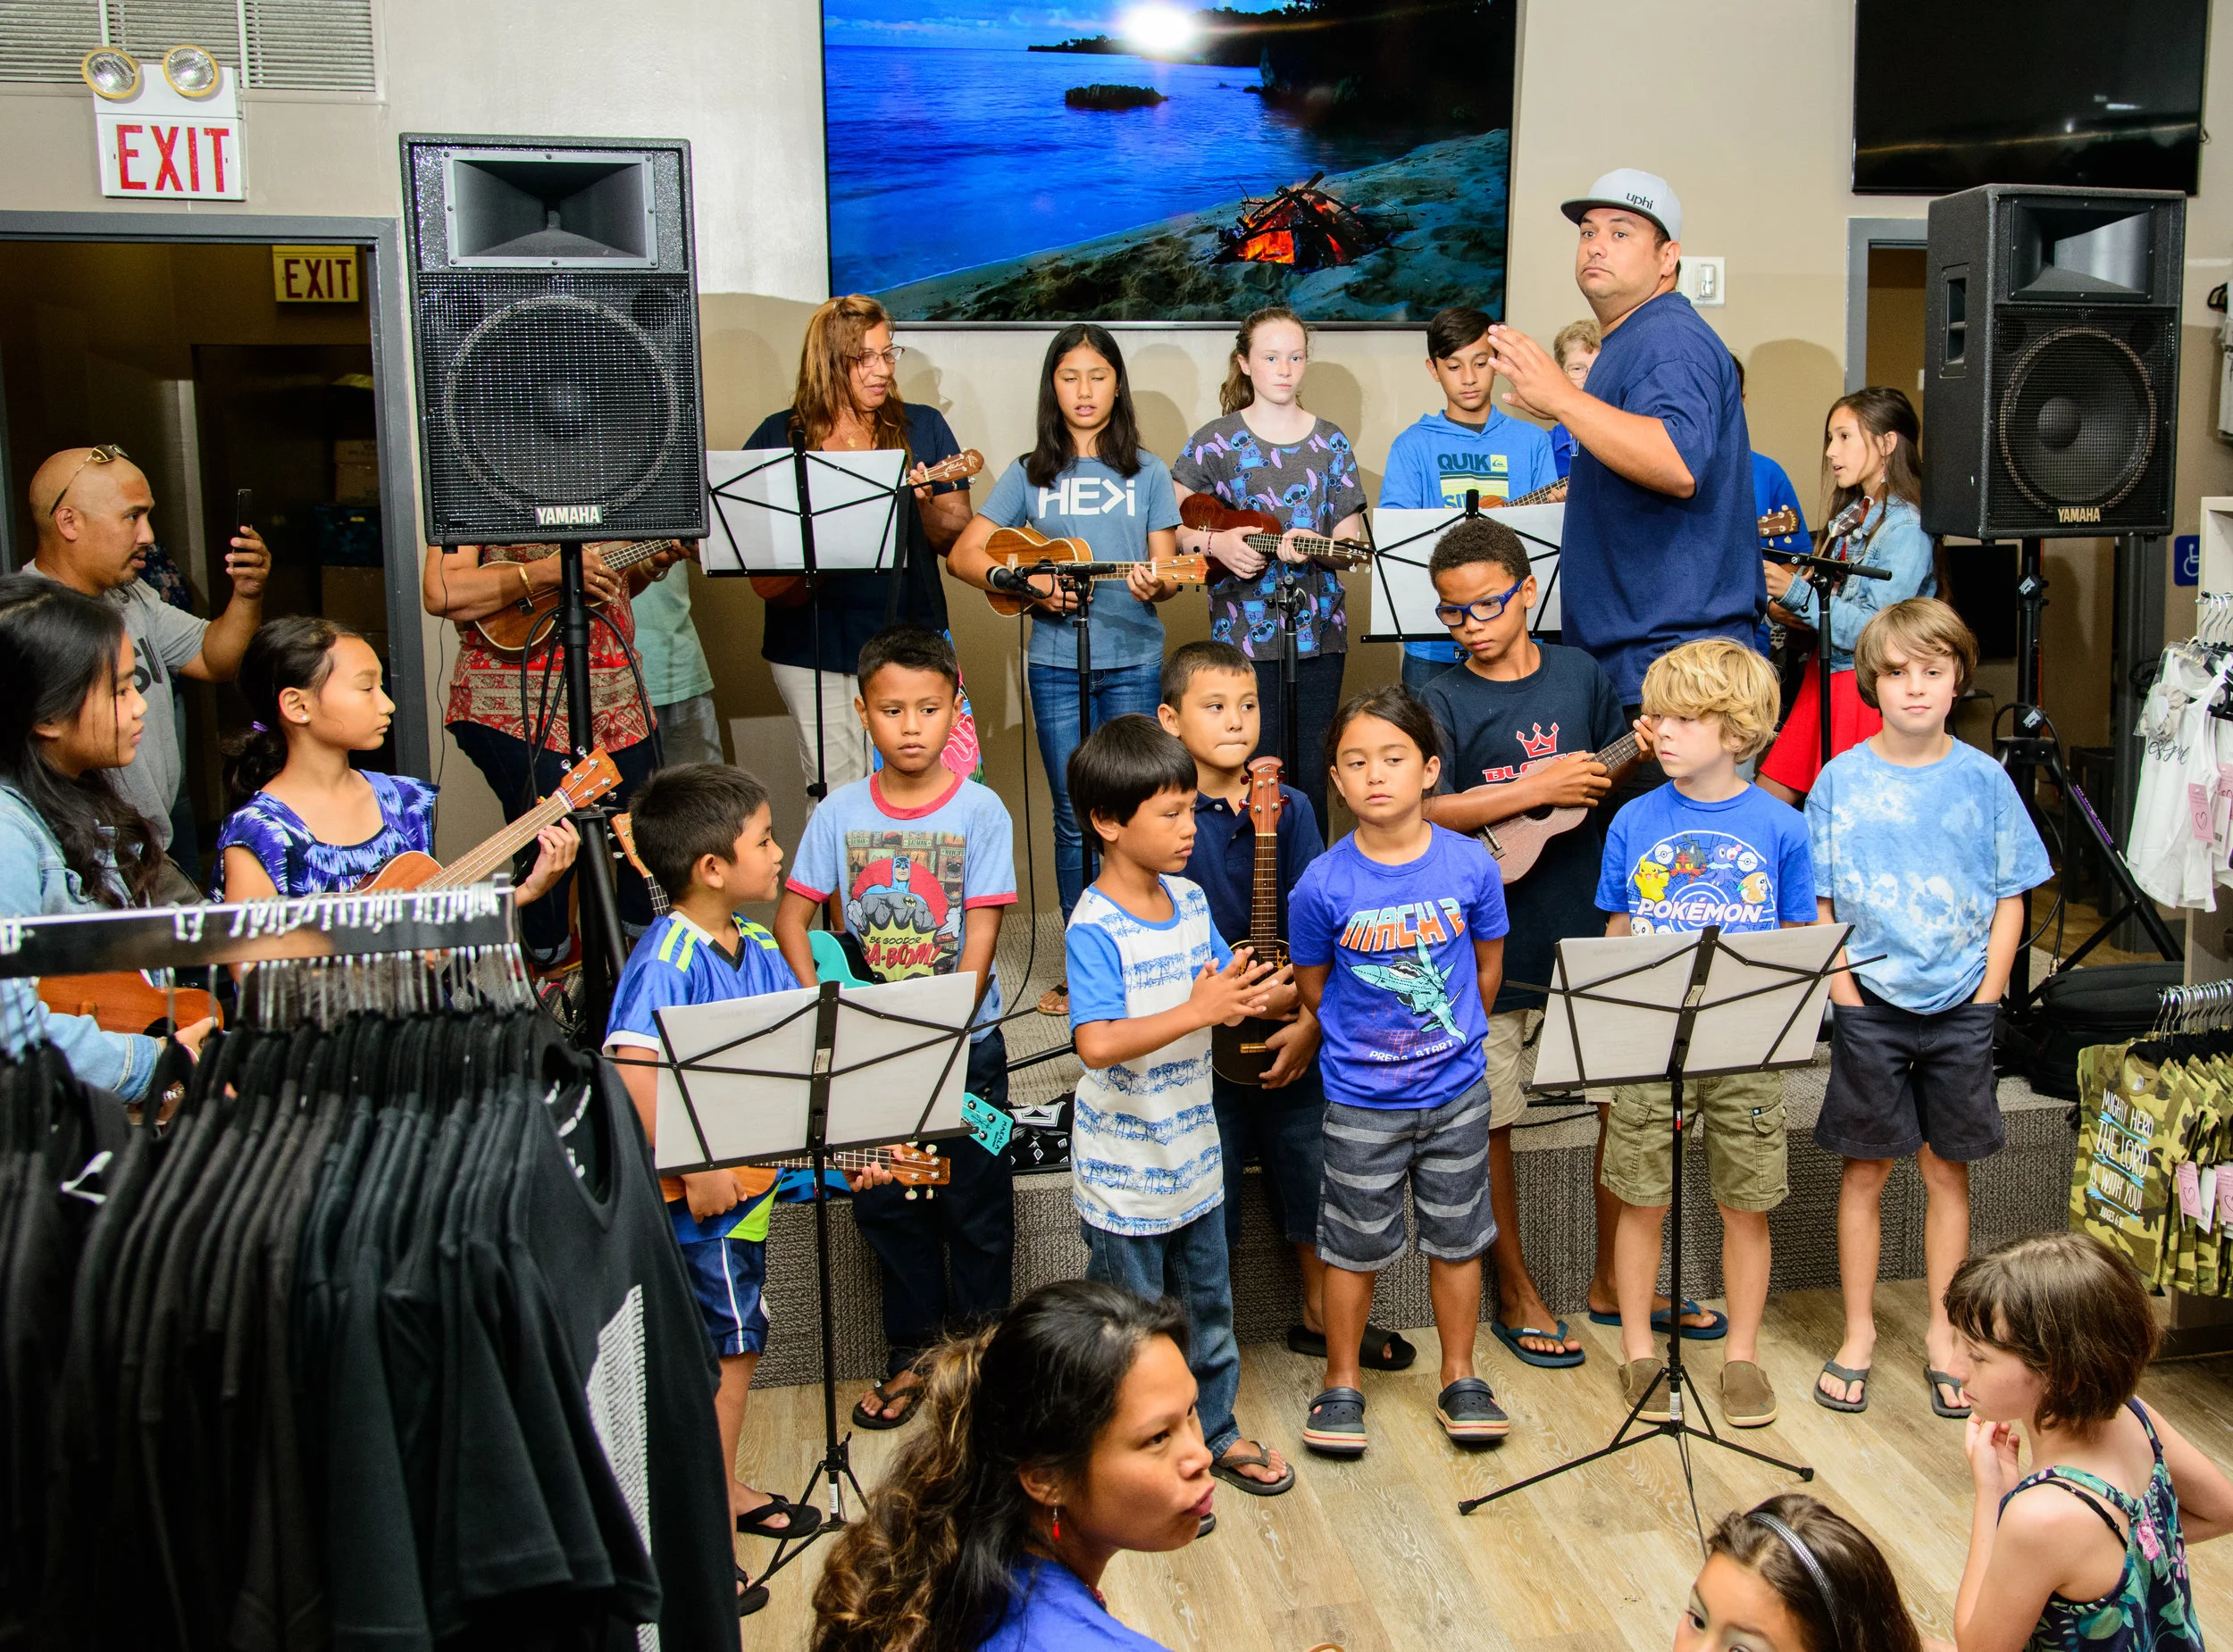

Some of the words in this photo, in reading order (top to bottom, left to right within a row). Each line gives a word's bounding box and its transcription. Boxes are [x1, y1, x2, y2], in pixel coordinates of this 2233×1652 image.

[115, 123, 230, 193] EXIT
[1626, 193, 1653, 210] uphi
[283, 258, 352, 299] EXIT
[1437, 453, 1491, 471] QUIK
[536, 506, 601, 524] YAMAHA
[2057, 507, 2101, 523] YAMAHA
[1635, 897, 1764, 923] POKÉMON
[1340, 900, 1448, 953] MACH
[1437, 897, 1467, 938] 2
[869, 936, 882, 944] BE
[1369, 1049, 1409, 1062] PRESS
[1416, 1039, 1454, 1058] START
[2102, 1088, 2128, 1125] MIGHTY
[2129, 1107, 2154, 1139] HERO
[994, 1120, 1008, 1150] MAKALA
[2096, 1118, 2119, 1160] THE
[2120, 1134, 2150, 1179] LORD
[2089, 1160, 2099, 1186] IS
[2100, 1169, 2124, 1200] WITH
[2123, 1181, 2143, 1214] YOU!
